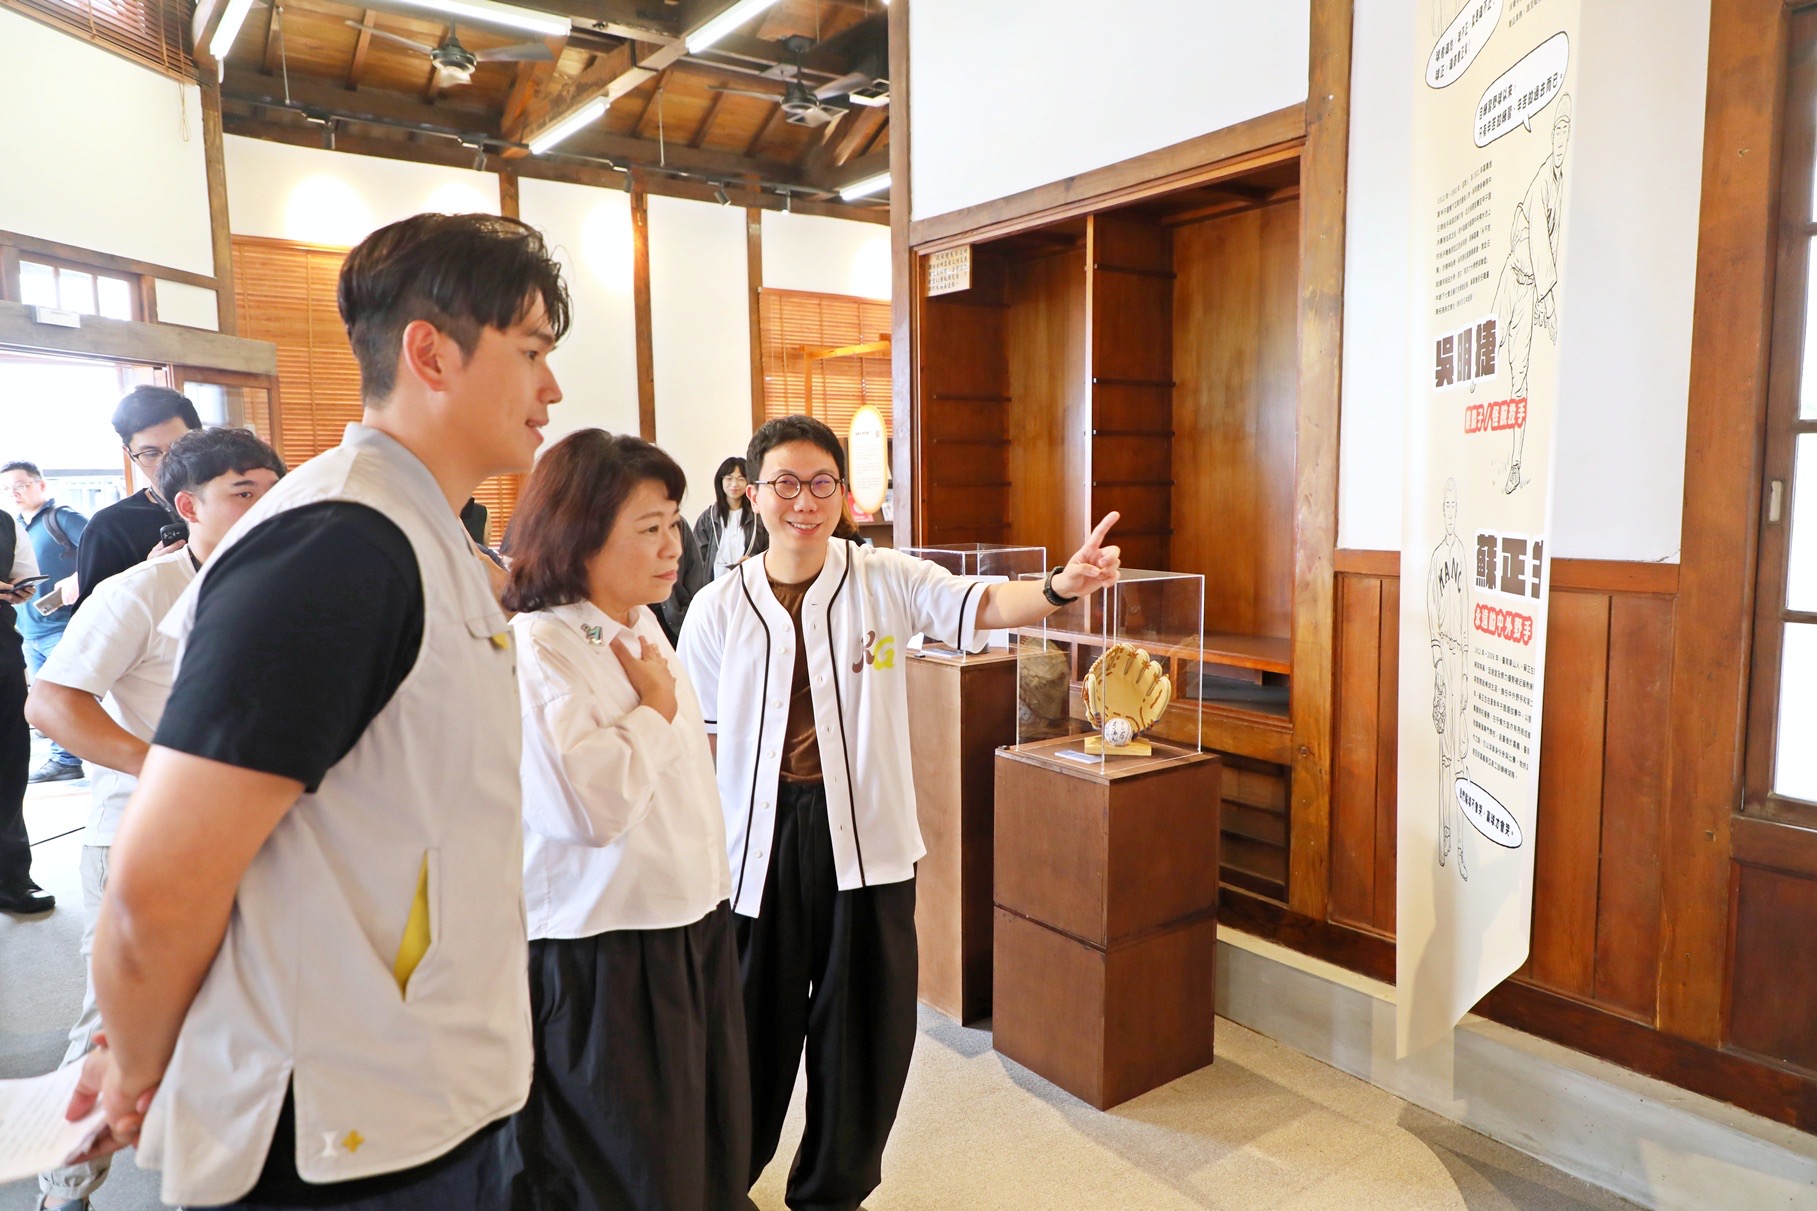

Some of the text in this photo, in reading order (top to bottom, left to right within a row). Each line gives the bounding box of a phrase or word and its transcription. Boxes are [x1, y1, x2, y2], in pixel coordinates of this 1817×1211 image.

[1435, 319, 1496, 388] 吳明捷
[1475, 605, 1533, 643] 永遠的中外野手
